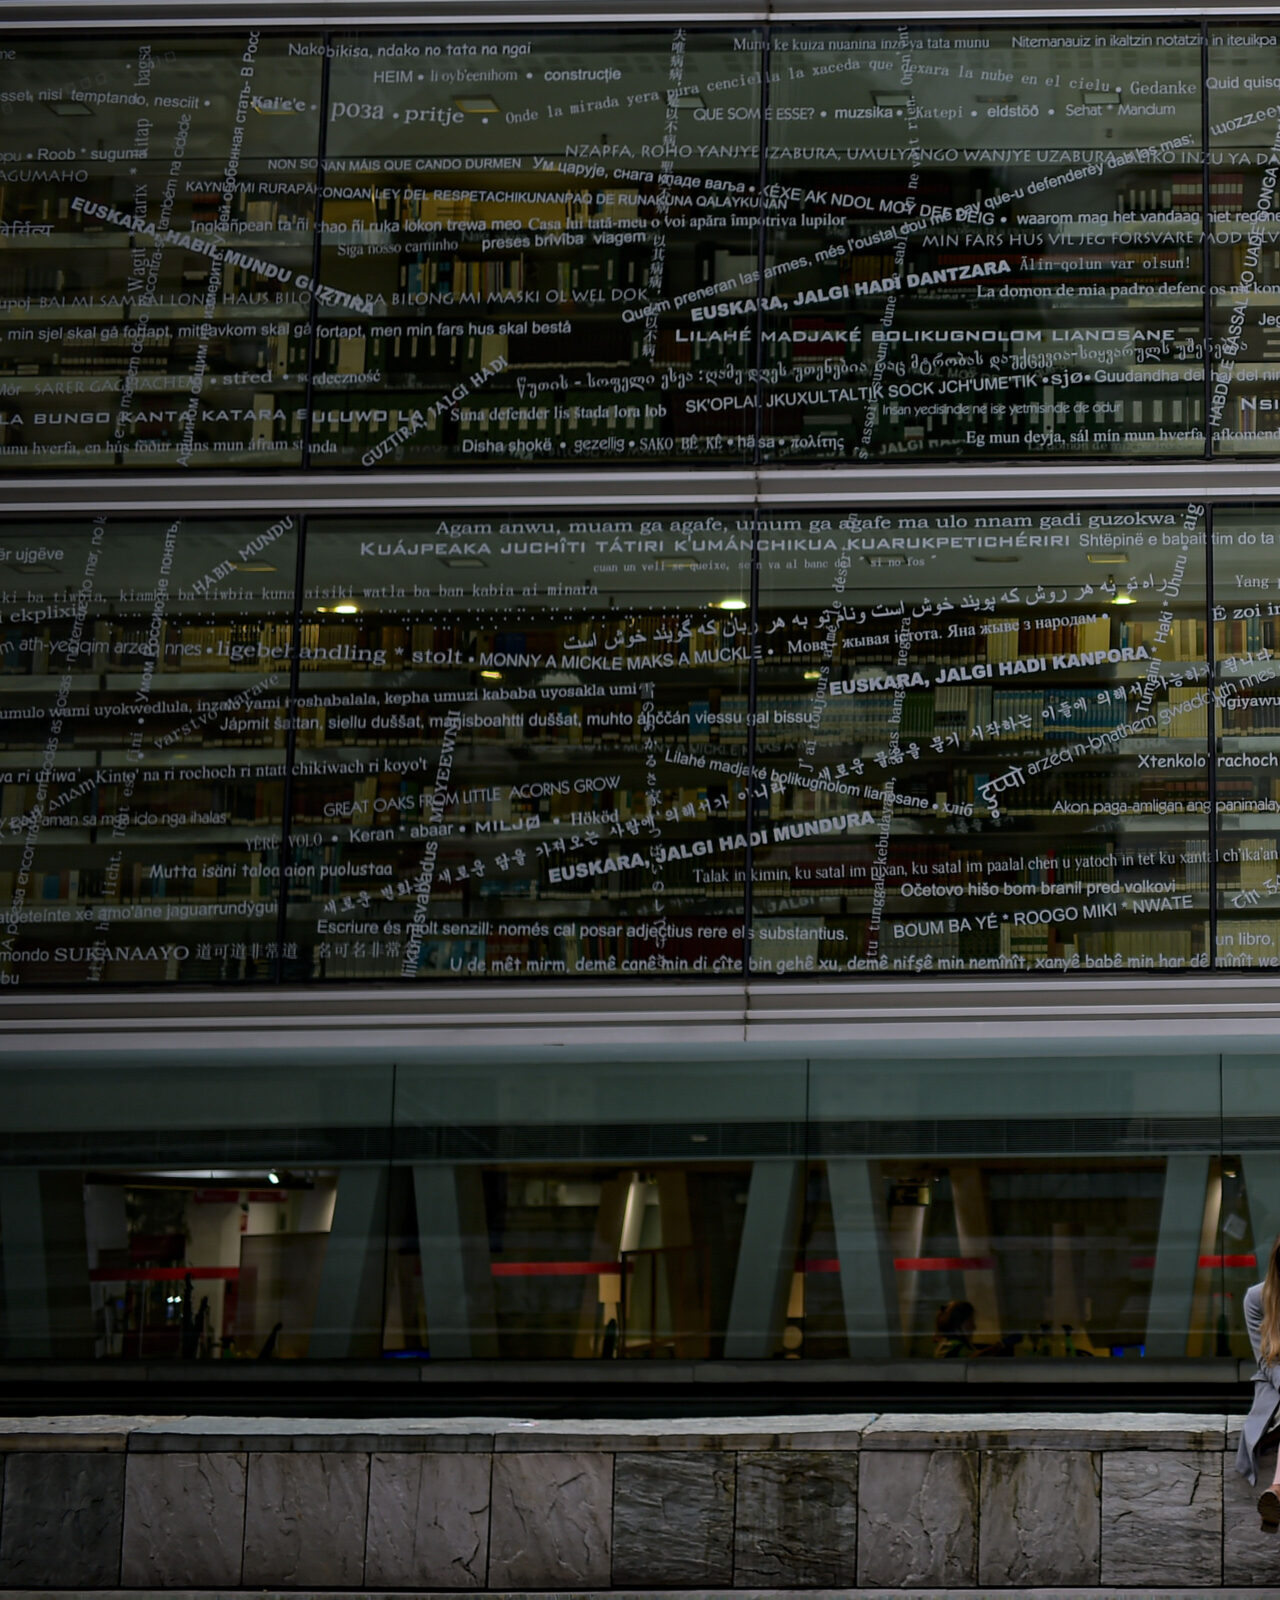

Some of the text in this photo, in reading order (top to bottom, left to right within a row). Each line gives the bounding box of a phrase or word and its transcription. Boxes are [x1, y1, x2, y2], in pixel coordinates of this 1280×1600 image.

[1110, 34, 1152, 46] ikaltzin
[378, 44, 420, 56] ndako
[447, 44, 476, 55] tata
[482, 45, 497, 55] na
[502, 42, 531, 58] ngai
[332, 102, 383, 119] роза
[405, 107, 464, 126] pritje
[693, 105, 723, 121] QUE
[776, 108, 815, 120] ESSE?
[835, 106, 893, 119] muzsika
[801, 213, 846, 230] lupilor
[1017, 209, 1200, 226] waarom mag vandaag
[482, 232, 647, 250] preses viagem
[922, 231, 1193, 247] MIN FARS HUS VIL JEG FORSVARE
[337, 243, 363, 257] Siga
[405, 240, 458, 252] caminho
[692, 296, 787, 320] EUSKARA,
[794, 285, 849, 305] JALGI
[907, 261, 1010, 287] DANTZARA
[371, 320, 571, 336] men min hus skal bestå
[676, 328, 1178, 344] LILAHÉ MADJAKÉ LIANOSANE
[362, 356, 507, 466] GUZTIRA, HADI
[489, 404, 609, 420] defender štada
[1241, 397, 1278, 410] NSI
[462, 437, 624, 453] Disha shokë gezellig
[436, 511, 1176, 537] Agam anwu, muam agafe, ma nnam gadi guzokwa
[191, 516, 293, 596] HABIL MUNDU
[361, 542, 491, 556] KUÁJPEAKA
[596, 541, 663, 552] TÁTIRI
[413, 648, 462, 664] stolt
[480, 651, 674, 672] MONNY A MICKLE MAKS
[936, 664, 992, 683] JALGI
[999, 657, 1046, 675] HADI
[1053, 646, 1149, 669] KANPORA
[385, 687, 536, 706] kepha kababa
[220, 713, 633, 730] Jápmit siellu muhto
[665, 750, 705, 768] Lilahé
[180, 759, 364, 780] rochoch chikiwach
[324, 776, 620, 816] GREAT OAKS LITTLE ACORNS GROW
[549, 811, 875, 882] EUSKARA, JALGI HADI MUNDURA
[149, 863, 392, 878] Mutta isäni taloa puolustaa
[900, 879, 1179, 897] Očetovo hišo bom branil volkovi
[894, 921, 943, 938] BOUM
[1014, 907, 1078, 925] ROOGO
[1083, 903, 1117, 919] MIKI
[1133, 895, 1193, 913] NWATE
[317, 920, 493, 935] Escriure senzill:
